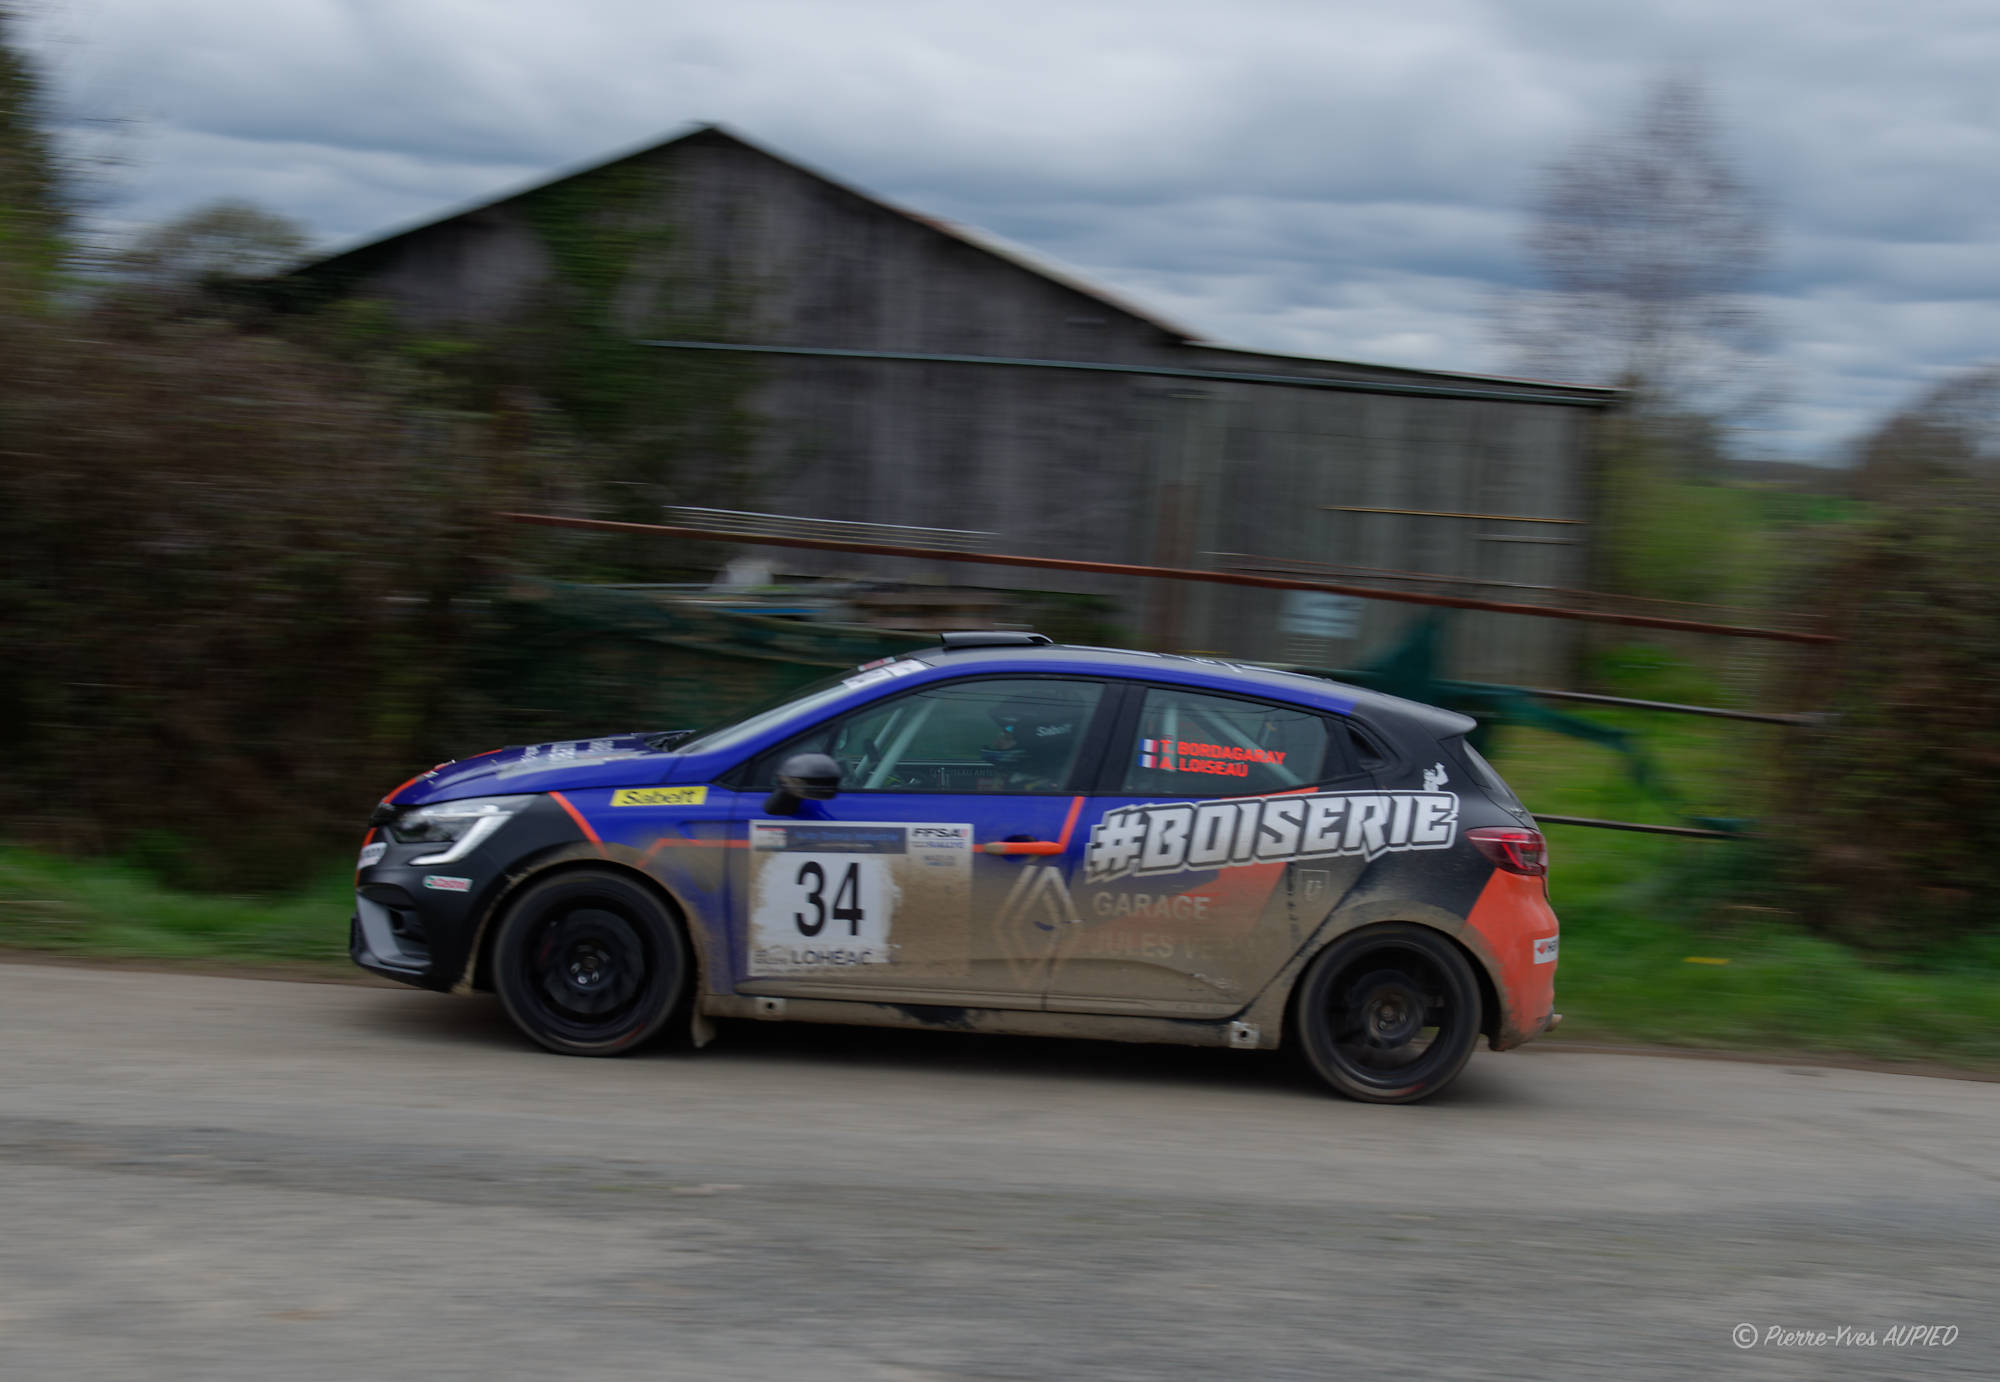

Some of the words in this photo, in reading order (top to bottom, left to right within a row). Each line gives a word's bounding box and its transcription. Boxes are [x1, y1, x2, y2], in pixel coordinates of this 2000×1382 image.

[1177, 741, 1286, 765] BORDAGARAY
[1179, 758, 1248, 777] LOISEAU
[1085, 791, 1459, 884] #BOISERIE
[794, 861, 865, 937] 34
[1092, 891, 1211, 920] GARAGE
